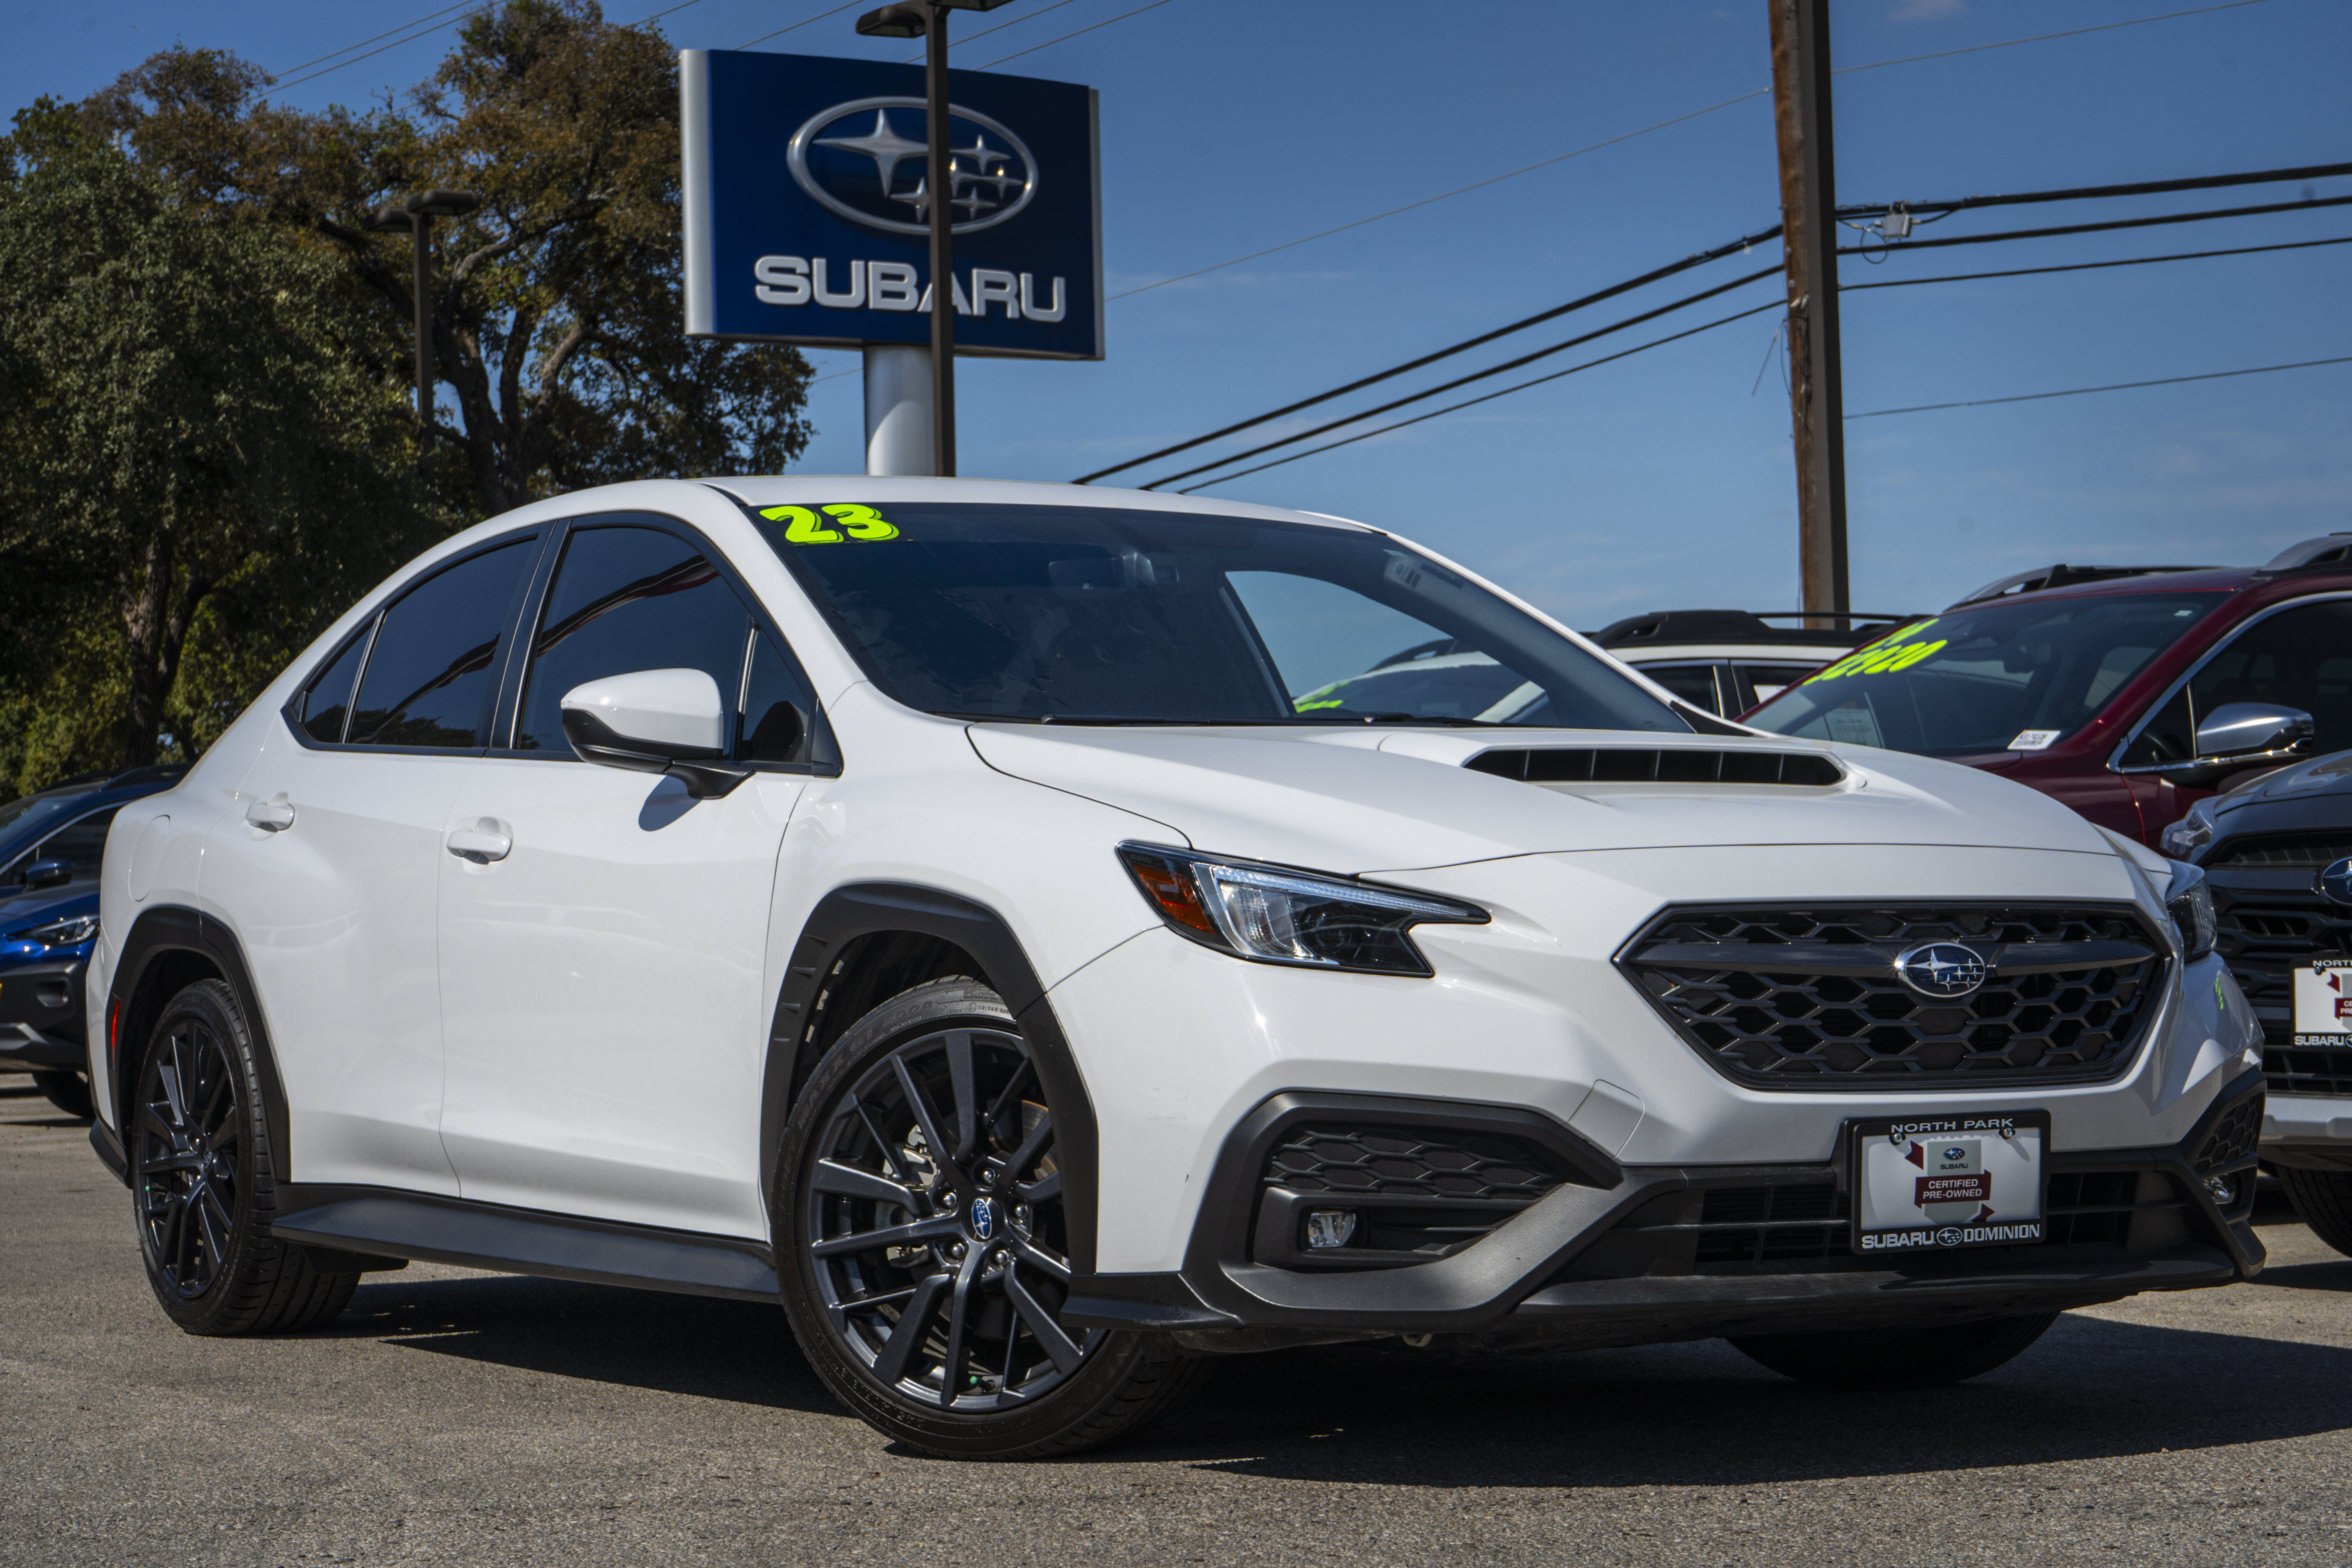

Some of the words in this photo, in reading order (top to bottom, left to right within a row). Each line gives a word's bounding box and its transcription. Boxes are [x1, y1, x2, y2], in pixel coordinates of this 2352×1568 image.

[759, 504, 900, 543] 23
[1130, 854, 1152, 863] SUBARU
[2294, 1036, 2344, 1046] SUBARU
[1891, 1121, 1956, 1133] NORTH
[1964, 1118, 2013, 1129] PARK
[1928, 1179, 1978, 1189] CERTIFIED
[1923, 1189, 1982, 1200] PRE-OWNED
[1862, 1231, 1936, 1249] SUBARU
[1963, 1224, 2040, 1243] DOMINION
